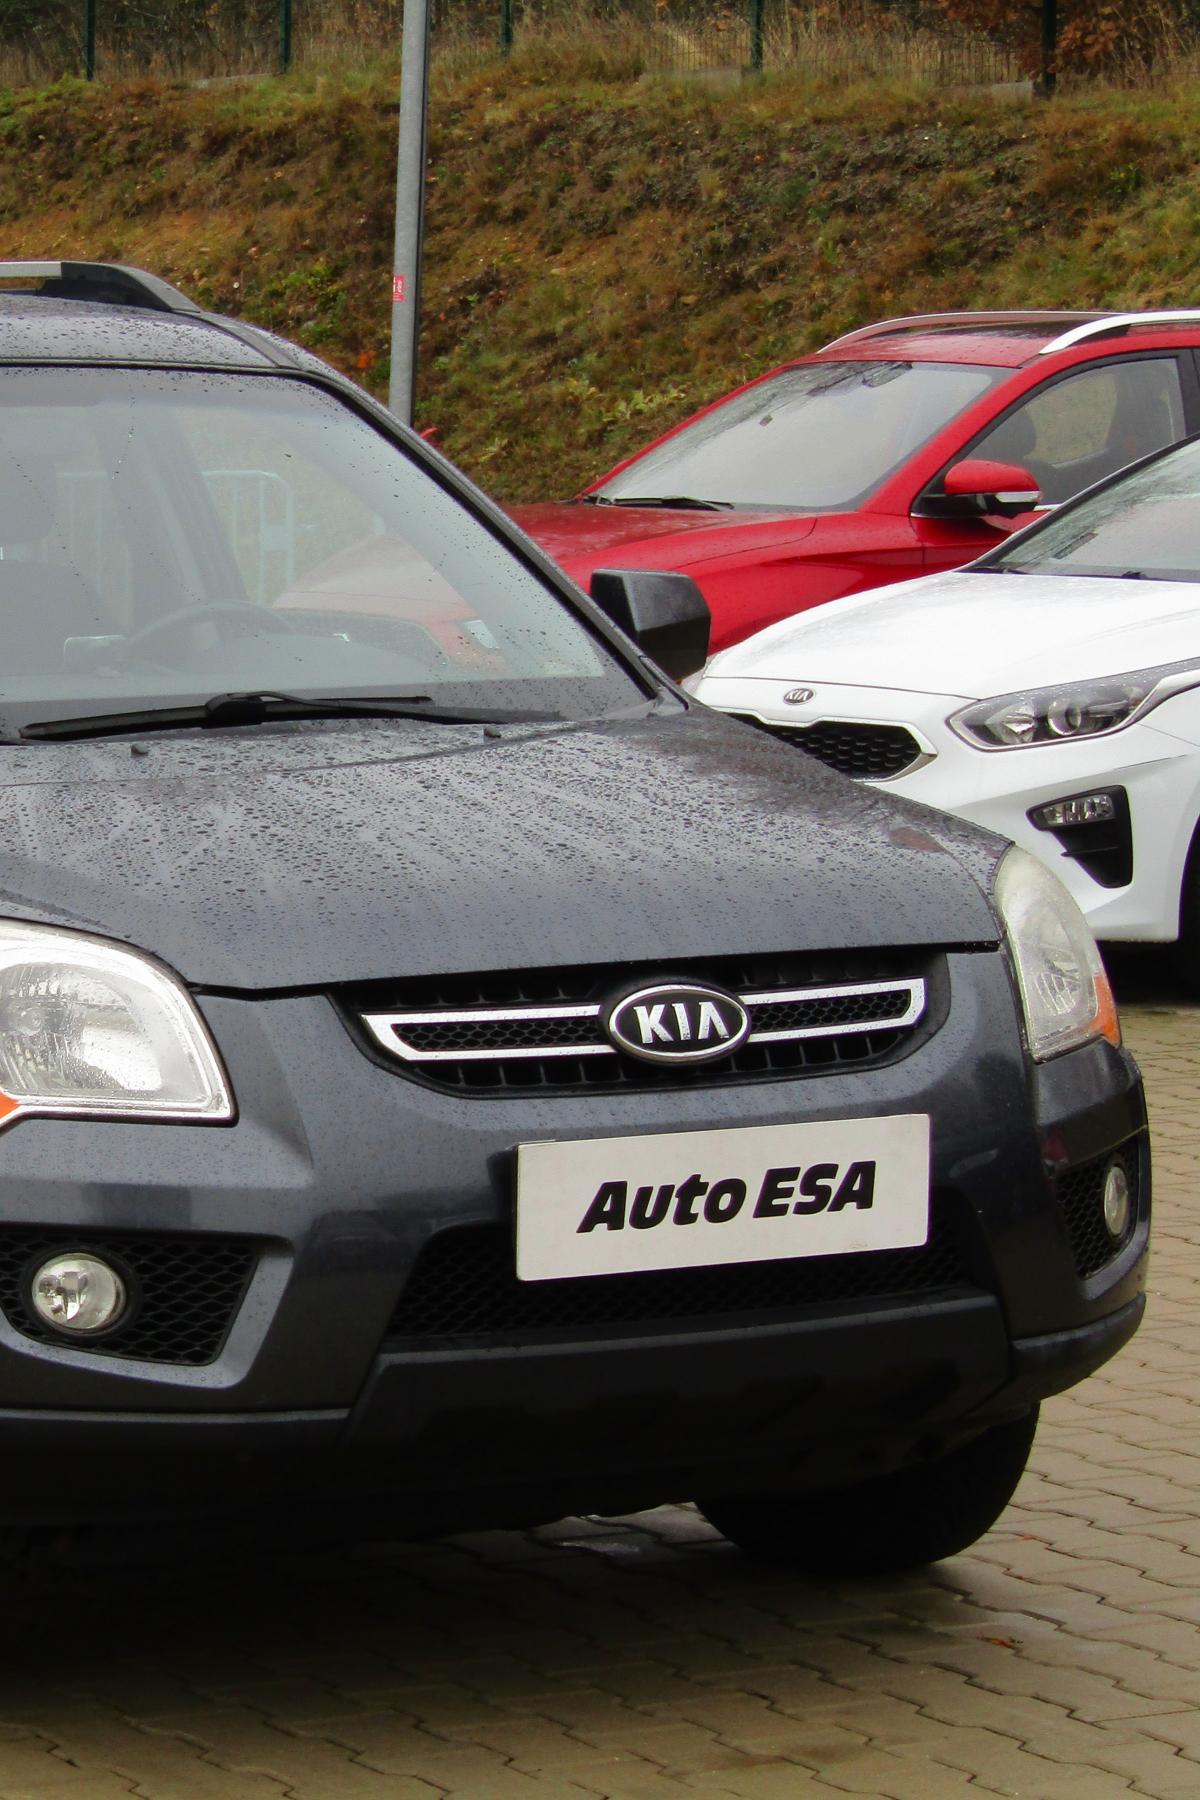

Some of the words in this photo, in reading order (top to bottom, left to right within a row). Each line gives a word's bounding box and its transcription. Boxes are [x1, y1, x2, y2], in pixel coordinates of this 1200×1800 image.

[633, 1002, 730, 1044] KIA
[575, 1174, 747, 1234] Auto
[752, 1160, 877, 1219] ESA
